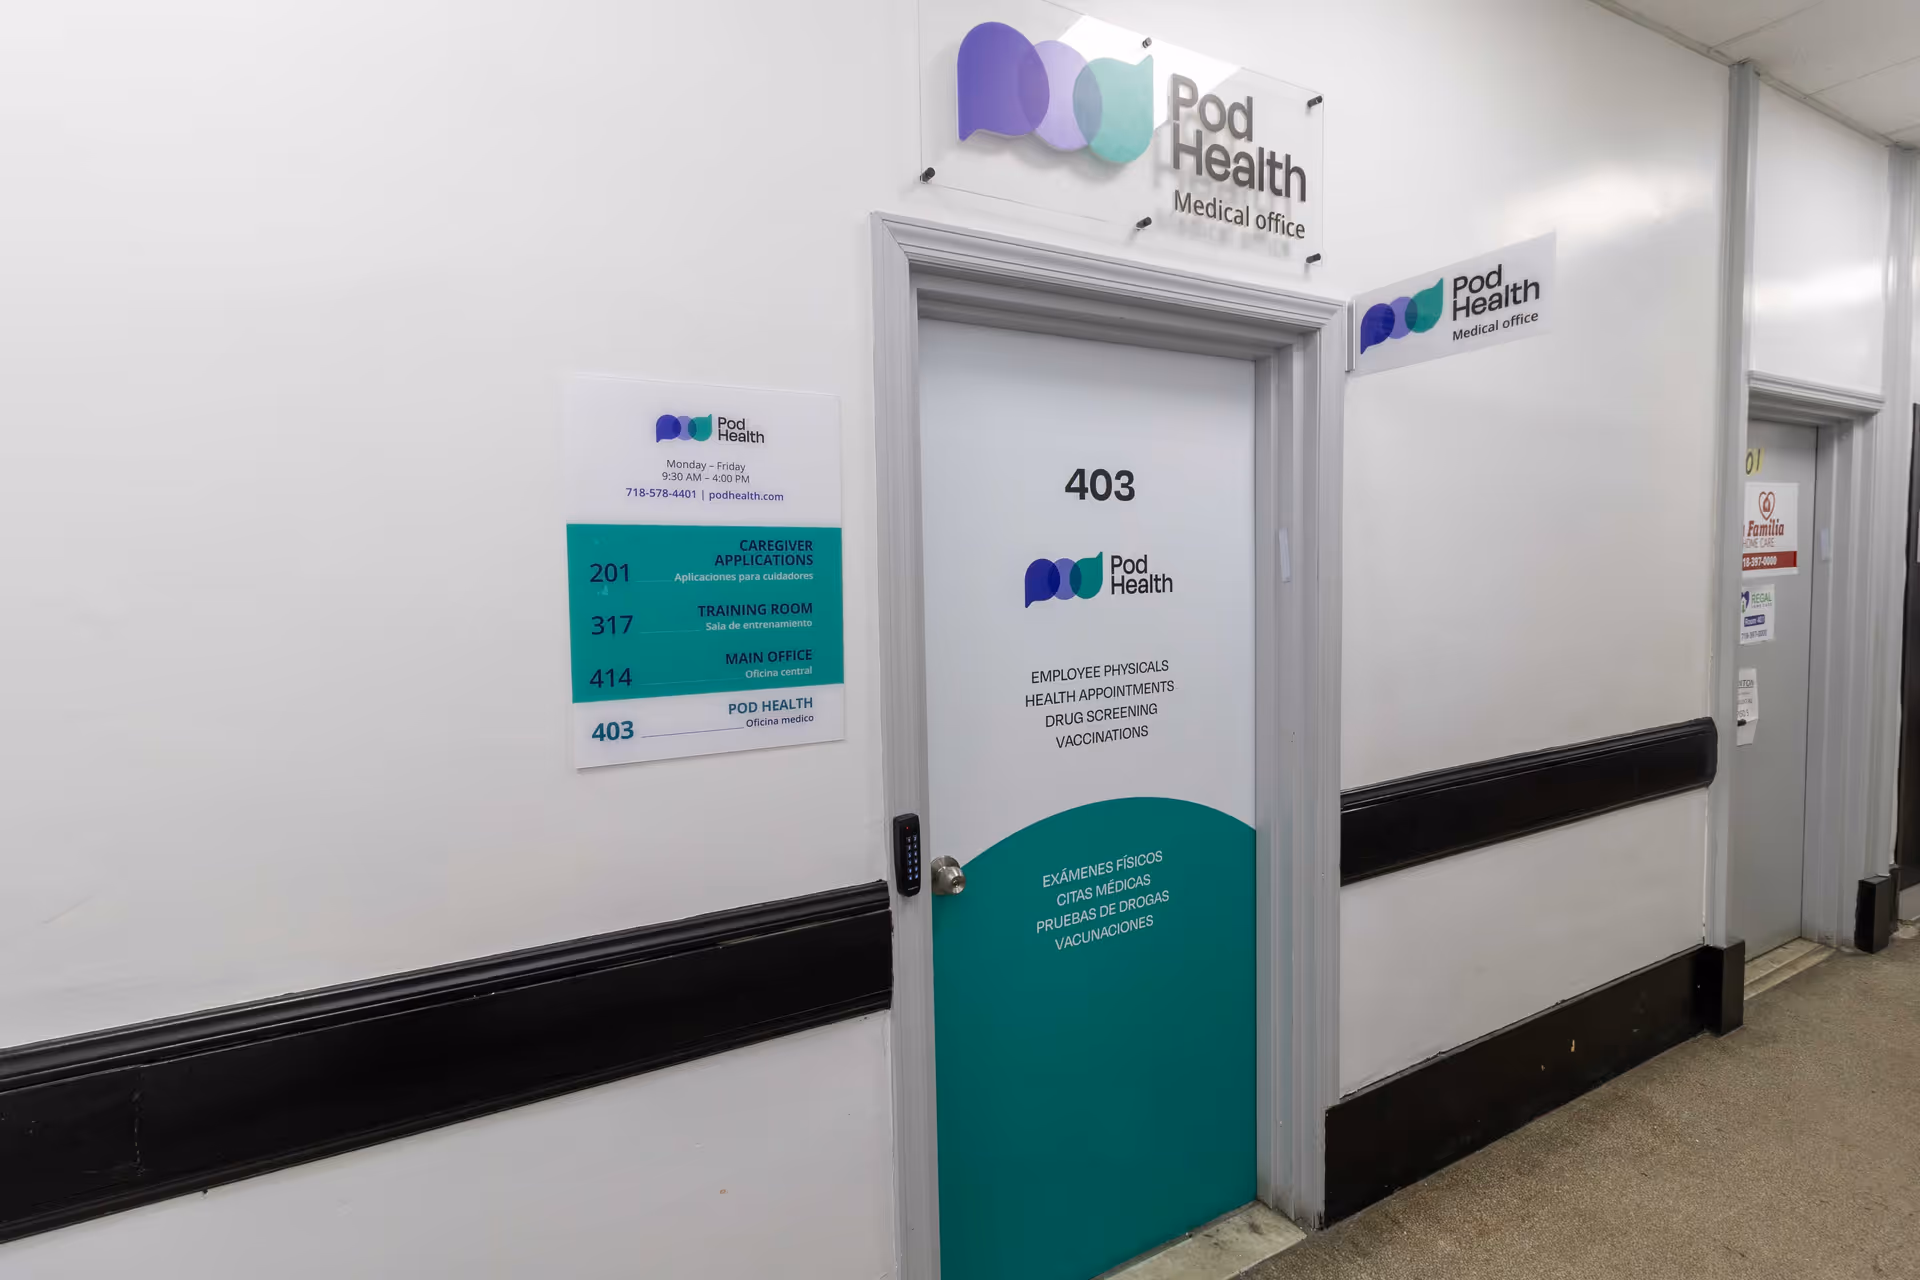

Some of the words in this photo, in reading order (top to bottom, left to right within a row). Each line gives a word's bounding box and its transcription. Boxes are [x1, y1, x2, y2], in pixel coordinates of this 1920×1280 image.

[1169, 73, 1254, 142] Pod
[1171, 122, 1306, 203] Health
[1174, 189, 1250, 227] Medical
[1255, 211, 1306, 239] office
[1453, 264, 1503, 299] Pod
[1452, 279, 1540, 321] Health
[1452, 320, 1499, 341] Medical
[1502, 313, 1539, 329] office
[717, 416, 746, 431] Pod
[717, 429, 765, 443] Health
[666, 459, 707, 472] Monday
[716, 461, 746, 473] Friday
[661, 472, 684, 482] 9:30
[686, 473, 702, 482] AM
[712, 473, 732, 483] 4:00
[734, 474, 750, 483] PM
[1064, 468, 1135, 501] 403
[625, 487, 697, 499] 718-578-4401
[708, 490, 784, 501] podhealth.com
[1747, 518, 1785, 537] Familia
[739, 539, 813, 552] CAREGIVER
[714, 554, 814, 567] APPLICATIONS
[1110, 554, 1148, 575] Pod
[589, 563, 630, 583] 201
[674, 572, 737, 584] Aplicaciones
[738, 574, 761, 583] para
[762, 572, 814, 582] cuidadores
[1110, 573, 1174, 595] Health
[698, 603, 767, 617] TRAINING
[771, 602, 813, 615] ROOM
[591, 614, 634, 635] 317
[705, 621, 727, 631] Sala
[728, 621, 741, 630] de
[743, 619, 813, 630] entrenamiento
[725, 651, 764, 665] MAIN
[767, 649, 813, 663] OFFICE
[589, 667, 633, 688] 414
[745, 668, 779, 679] Oficina
[780, 666, 813, 677] central
[1031, 665, 1101, 684] EMPLOYEE
[1104, 659, 1169, 677] PHYSICALS
[1025, 690, 1076, 708] HEALTH
[1078, 680, 1175, 702] APPOINTMENTS
[728, 700, 758, 715] POD
[762, 697, 813, 713] HEALTH
[1045, 711, 1084, 728] DRUG
[1086, 702, 1158, 723] SCREENING
[591, 720, 634, 742] 403
[745, 717, 779, 728] Oficina
[781, 714, 814, 725] medico
[1055, 725, 1149, 749] VACCINATIONS
[1042, 861, 1113, 888] EXÁMENES
[1116, 850, 1163, 871] FÍSICOS
[1056, 887, 1093, 907] CITAS
[1096, 873, 1151, 897] MÉDICAS
[1036, 908, 1097, 934] PRUEBAS
[1099, 902, 1117, 918] DE
[1119, 890, 1170, 913] DROGAS
[1054, 914, 1154, 951] VACUNACIONES
